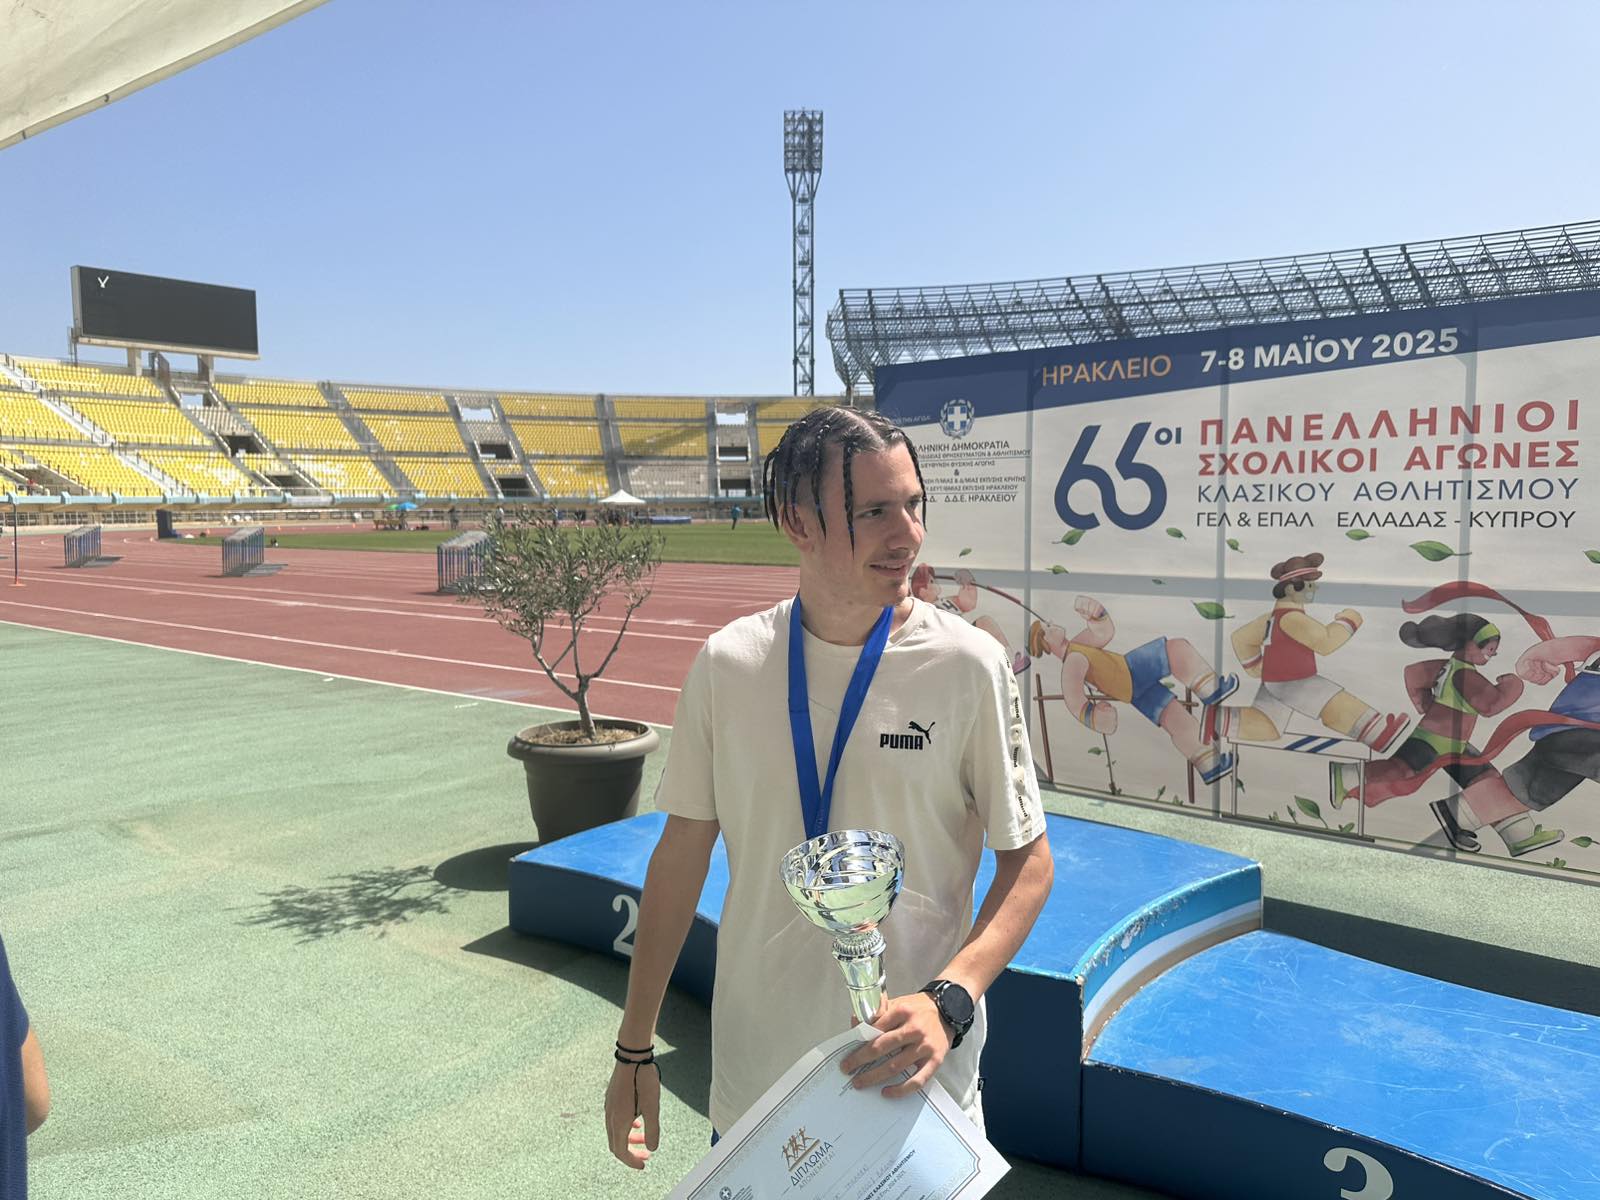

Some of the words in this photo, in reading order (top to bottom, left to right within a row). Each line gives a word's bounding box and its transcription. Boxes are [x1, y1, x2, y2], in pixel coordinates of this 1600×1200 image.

[1042, 354, 1172, 386] ΗΡΑΚΛΕΙΟ
[1200, 346, 1245, 373] 7-8
[1253, 335, 1363, 369] ΜΑΪΟΥ
[1371, 327, 1459, 358] 2025
[1200, 399, 1579, 446] ΠΑΝΕΛΛΗΝΙΟΙ
[914, 444, 950, 453] ΛΗΝΙΚΗ
[951, 440, 1010, 451] ΔΗΜΟΚΡΑΤΙΑ
[1198, 447, 1377, 477] ΣΧΟΛΙΚΟΙ
[1403, 440, 1580, 471] ΑΓΩΝΕΣ
[968, 493, 1017, 502] ΗΡΑΚΛΕΙΟΥ
[1197, 482, 1335, 503] ΚΛΑΣΙΚΟΥ
[1353, 477, 1579, 502] ΑΘΛΗΤΙΣΜΟΥ
[1196, 511, 1233, 528] ΓΕΛ
[1236, 511, 1252, 527] &
[1257, 511, 1314, 528] ΕΠΑΛ
[1337, 511, 1448, 528] ΕΛΛΑΔΑΣ
[1469, 510, 1577, 529] ΚΥΠΡΟΥ
[879, 733, 924, 751] PUMA
[612, 894, 640, 958] 2
[790, 1141, 834, 1187] ΔΙΠΛΩΜΑ
